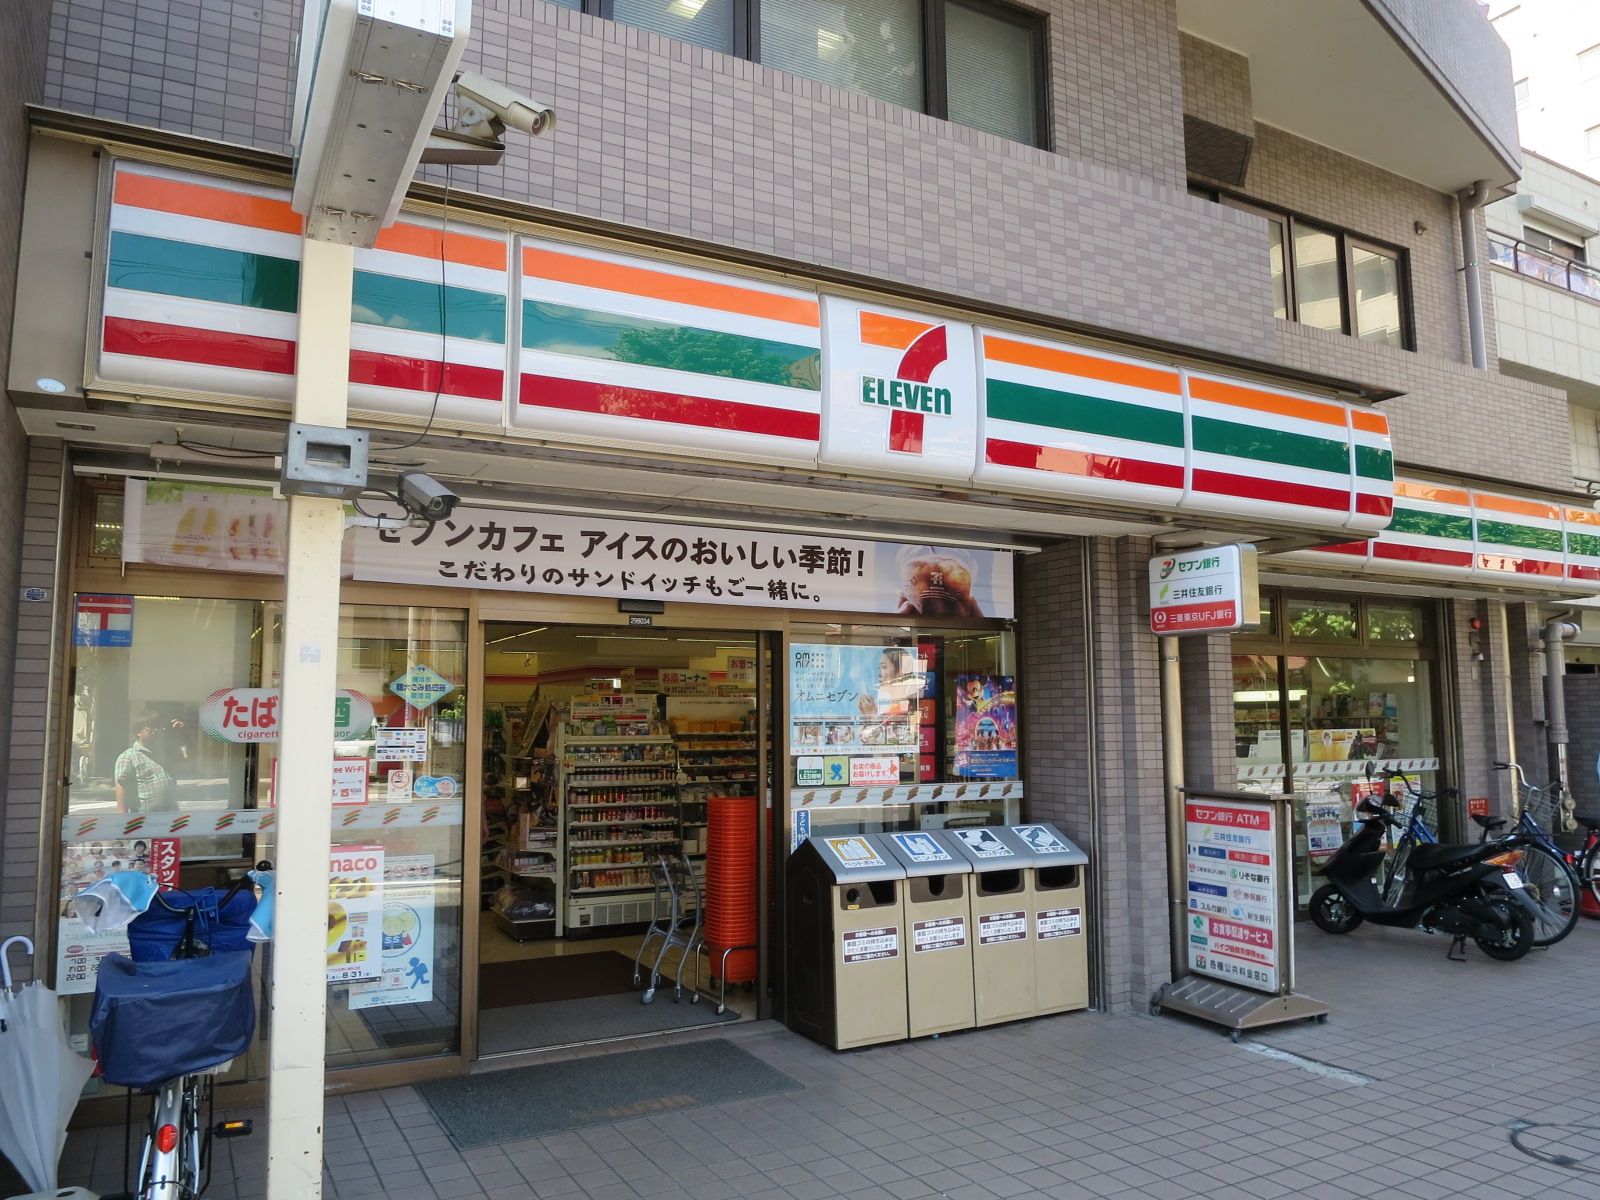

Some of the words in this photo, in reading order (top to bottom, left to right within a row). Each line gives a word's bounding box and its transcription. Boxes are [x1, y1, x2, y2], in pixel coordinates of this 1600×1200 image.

[580, 530, 865, 577] アイスのおいしい季節!
[1178, 556, 1221, 572] セブン銀行
[438, 560, 821, 603] こだわりのサンドイッチもご一緒に。
[1173, 584, 1223, 600] 三井住友銀行
[630, 616, 651, 626] 298034
[1169, 609, 1232, 624] 三菱東京UFJ銀行
[796, 689, 859, 703] オムニセブン
[222, 695, 280, 729] たば
[1195, 808, 1233, 823] セブン銀行
[1236, 813, 1260, 826] ATM
[1213, 832, 1252, 845] 三井住友銀行
[330, 857, 377, 873] naco
[1238, 870, 1270, 884] りそな銀行
[1209, 959, 1268, 983] 各種公共料金窓口
